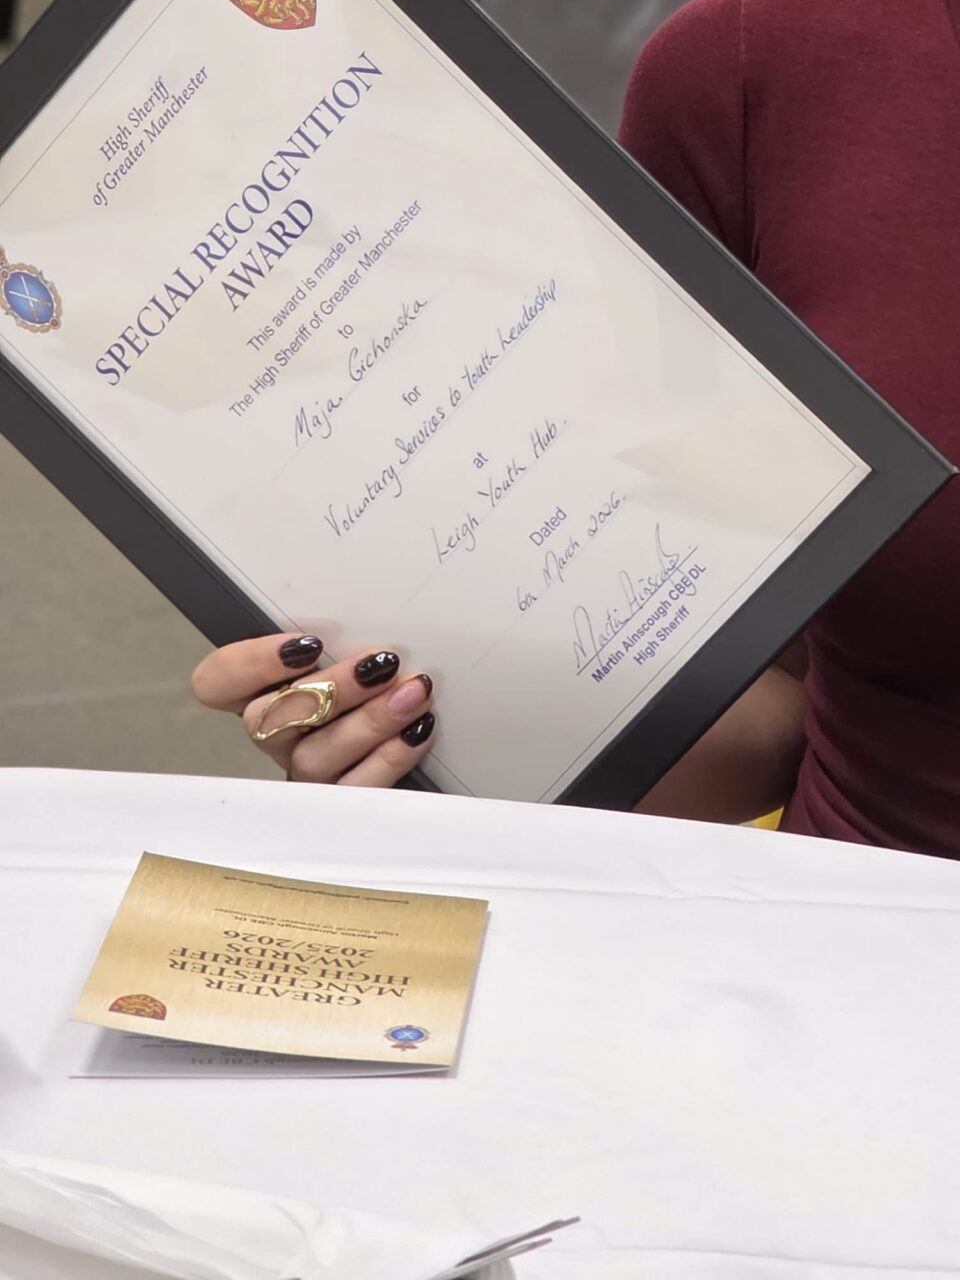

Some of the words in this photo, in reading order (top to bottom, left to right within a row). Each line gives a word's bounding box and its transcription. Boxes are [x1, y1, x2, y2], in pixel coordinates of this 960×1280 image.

[92, 185, 108, 207] of
[103, 139, 146, 190] Greater
[143, 66, 208, 144] Manchester
[99, 125, 133, 162] High
[127, 75, 170, 129] Sheriff
[95, 267, 205, 386] SPECIAL
[190, 50, 384, 274] RECOGNITION
[221, 199, 314, 312] AWARD
[228, 393, 255, 417] The
[248, 365, 280, 395] High
[274, 323, 312, 367] Sheriff
[309, 310, 324, 330] of
[319, 268, 362, 316] Greater
[357, 199, 422, 272] Manchester
[245, 325, 275, 352] This
[272, 285, 307, 328] award
[300, 277, 318, 292] is
[313, 242, 347, 280] made
[340, 225, 362, 245] by
[337, 324, 354, 340] to
[323, 465, 403, 537] Voluntary
[394, 406, 446, 465] Services
[449, 387, 462, 408] to
[460, 350, 499, 391] Youth
[497, 278, 557, 351] Leadership
[401, 385, 422, 407] for
[473, 451, 489, 469] at
[431, 512, 480, 565] Leigh
[477, 459, 527, 509] Youth
[528, 506, 568, 547] Dated
[542, 536, 581, 588] March
[590, 650, 625, 684] Martin
[621, 600, 672, 653] Ainscough
[668, 576, 692, 601] CBE
[687, 563, 707, 581] DL
[633, 640, 660, 666] High
[655, 604, 690, 642] Sheriff
[169, 947, 315, 976] SHERIFF
[223, 930, 376, 958] 2025/2026
[227, 943, 367, 969] AWARDS
[168, 958, 406, 998] MANCHESTER
[205, 978, 362, 1006] GREATER
[319, 968, 413, 986] HIGH
